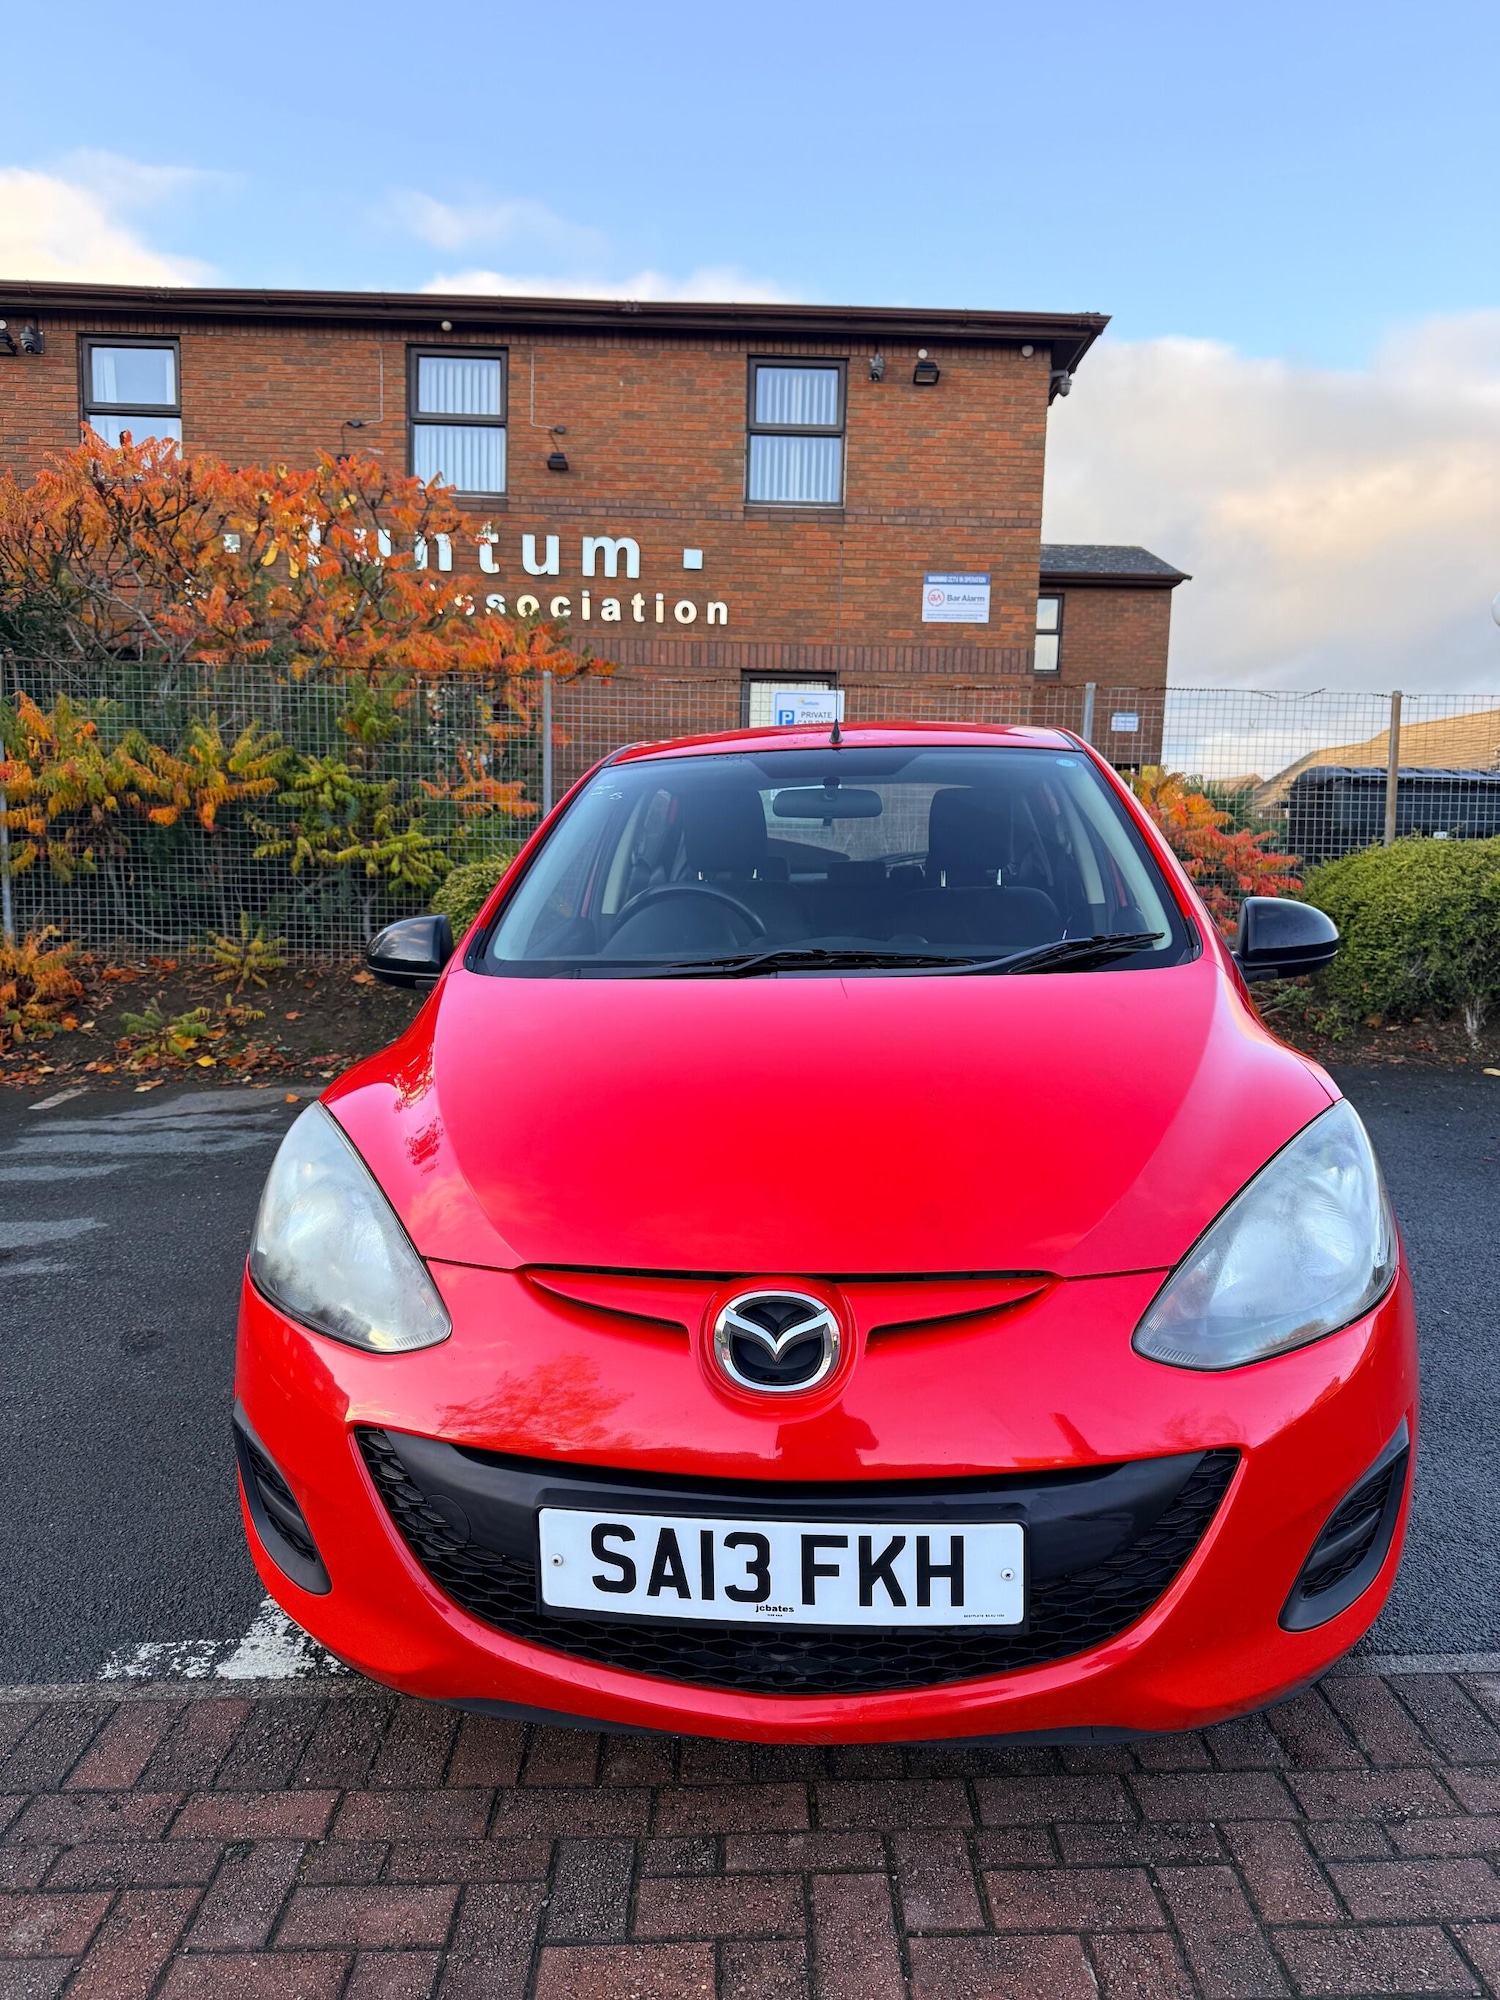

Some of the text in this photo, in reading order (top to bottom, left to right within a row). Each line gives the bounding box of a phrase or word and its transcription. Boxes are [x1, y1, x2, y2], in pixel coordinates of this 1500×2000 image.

[781, 711, 793, 725] P
[801, 711, 832, 719] PRIVATE
[590, 1523, 965, 1607] SA13 FKH
[755, 1604, 794, 1613] jcbates
